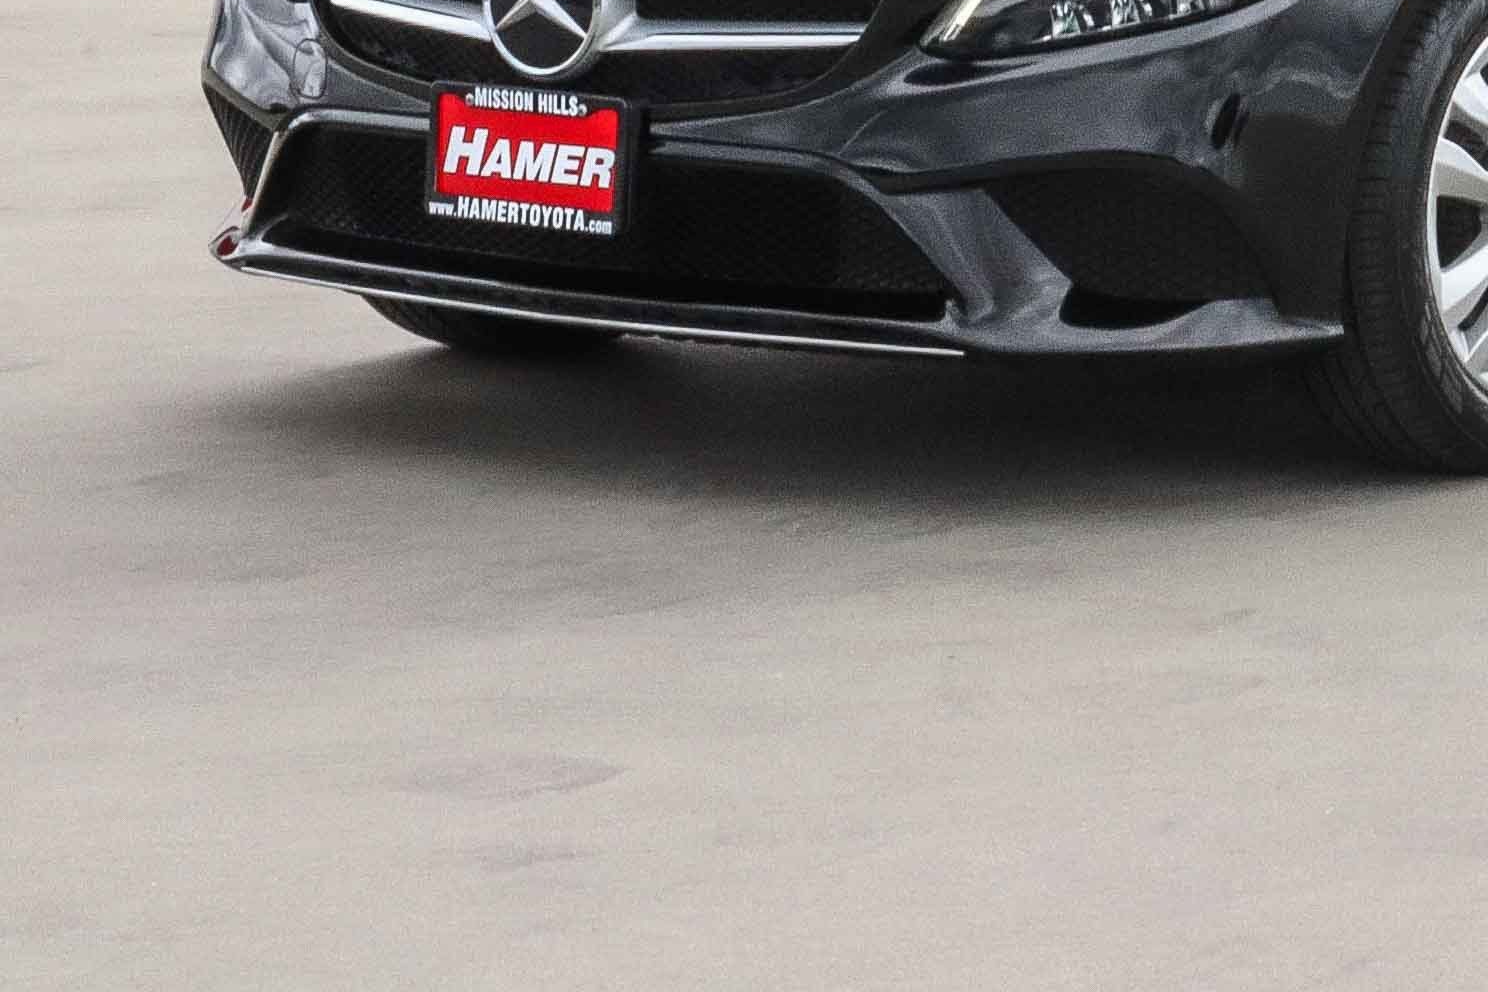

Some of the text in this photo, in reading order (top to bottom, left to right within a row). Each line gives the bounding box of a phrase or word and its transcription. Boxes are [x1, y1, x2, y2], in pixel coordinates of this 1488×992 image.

[474, 87, 578, 116] MISSION HILLS
[443, 125, 616, 189] HAMER
[428, 195, 613, 234] www.HAMERTOYOTA.com
